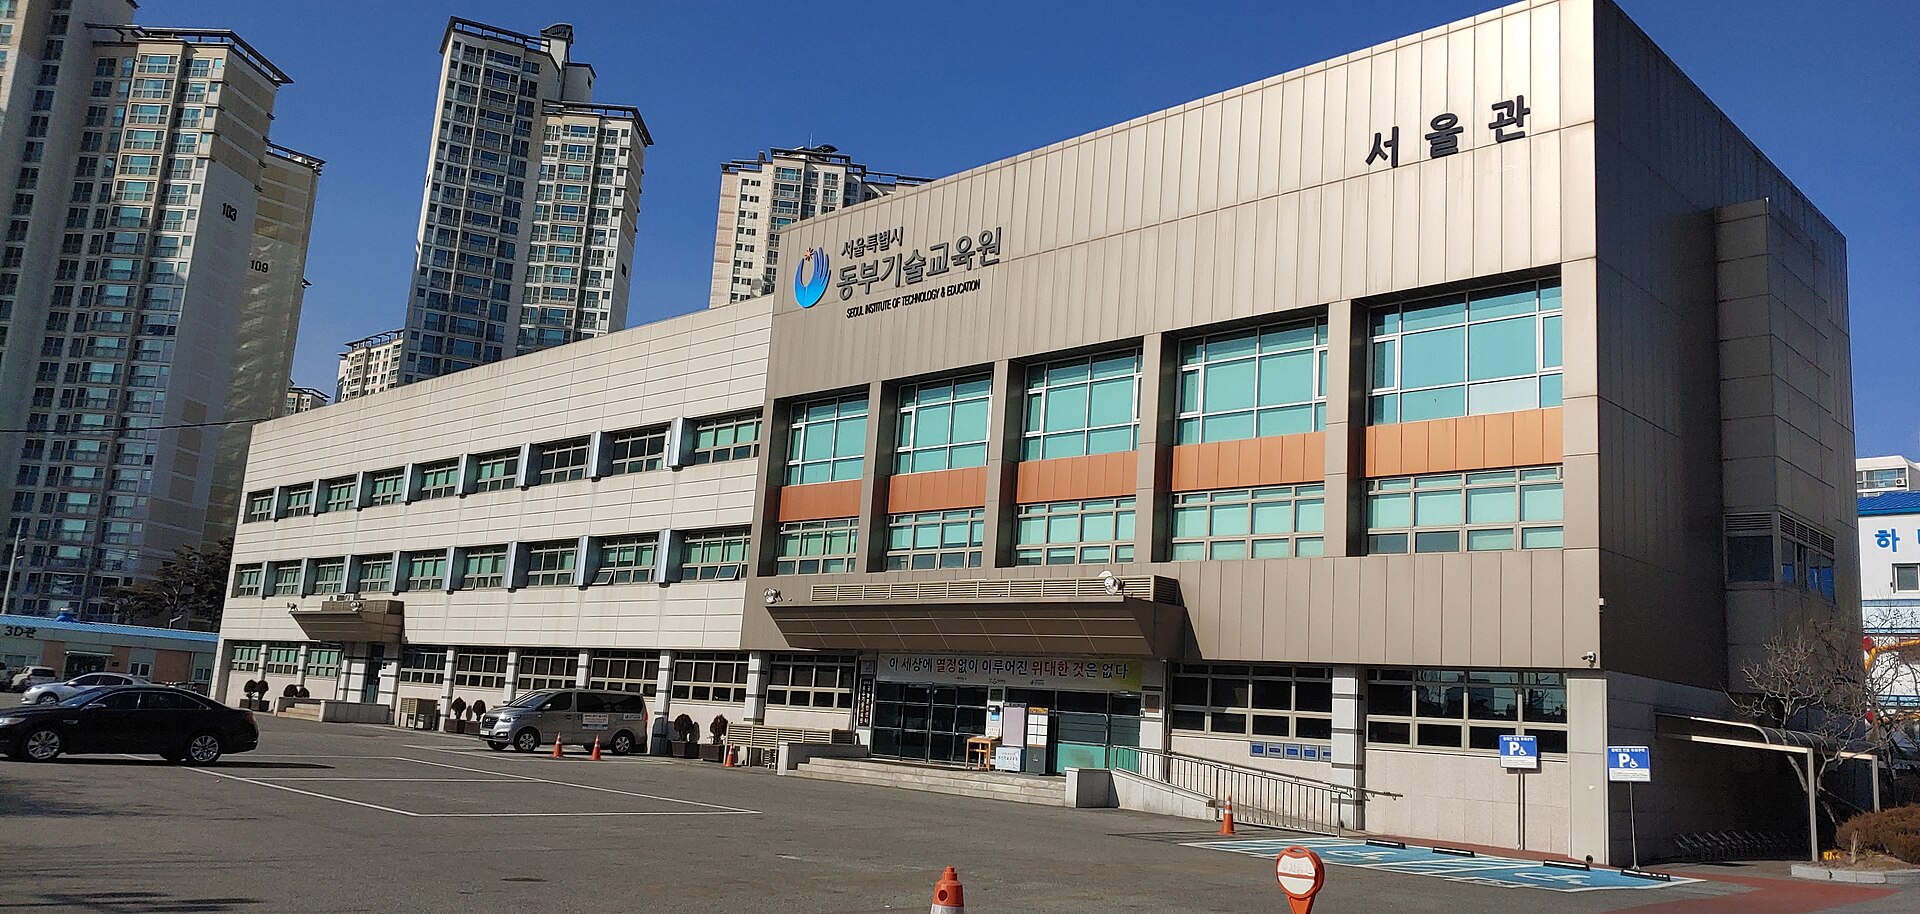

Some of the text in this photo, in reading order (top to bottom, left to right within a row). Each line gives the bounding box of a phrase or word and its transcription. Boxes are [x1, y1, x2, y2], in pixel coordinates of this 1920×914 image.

[222, 202, 238, 222] 103
[840, 226, 904, 260] 서울특별시
[250, 259, 269, 274] 109
[836, 226, 1003, 301] 동부기술교육원
[846, 306, 864, 319] SEOUL
[864, 300, 892, 315] INSTITUTE
[892, 296, 901, 309] OF
[901, 287, 941, 307] TECHNOLOGY
[946, 279, 981, 297] EDUCATION
[4, 625, 37, 639] 3D관
[889, 657, 898, 672] 이
[901, 657, 933, 673] 세상에
[936, 657, 978, 675] 열정없이
[982, 659, 1028, 676] 이루어진
[1031, 660, 1069, 677] 위대한
[1073, 661, 1098, 678] 것은
[1102, 663, 1129, 680] 없다
[1509, 741, 1520, 756] P
[1618, 752, 1630, 768] P
